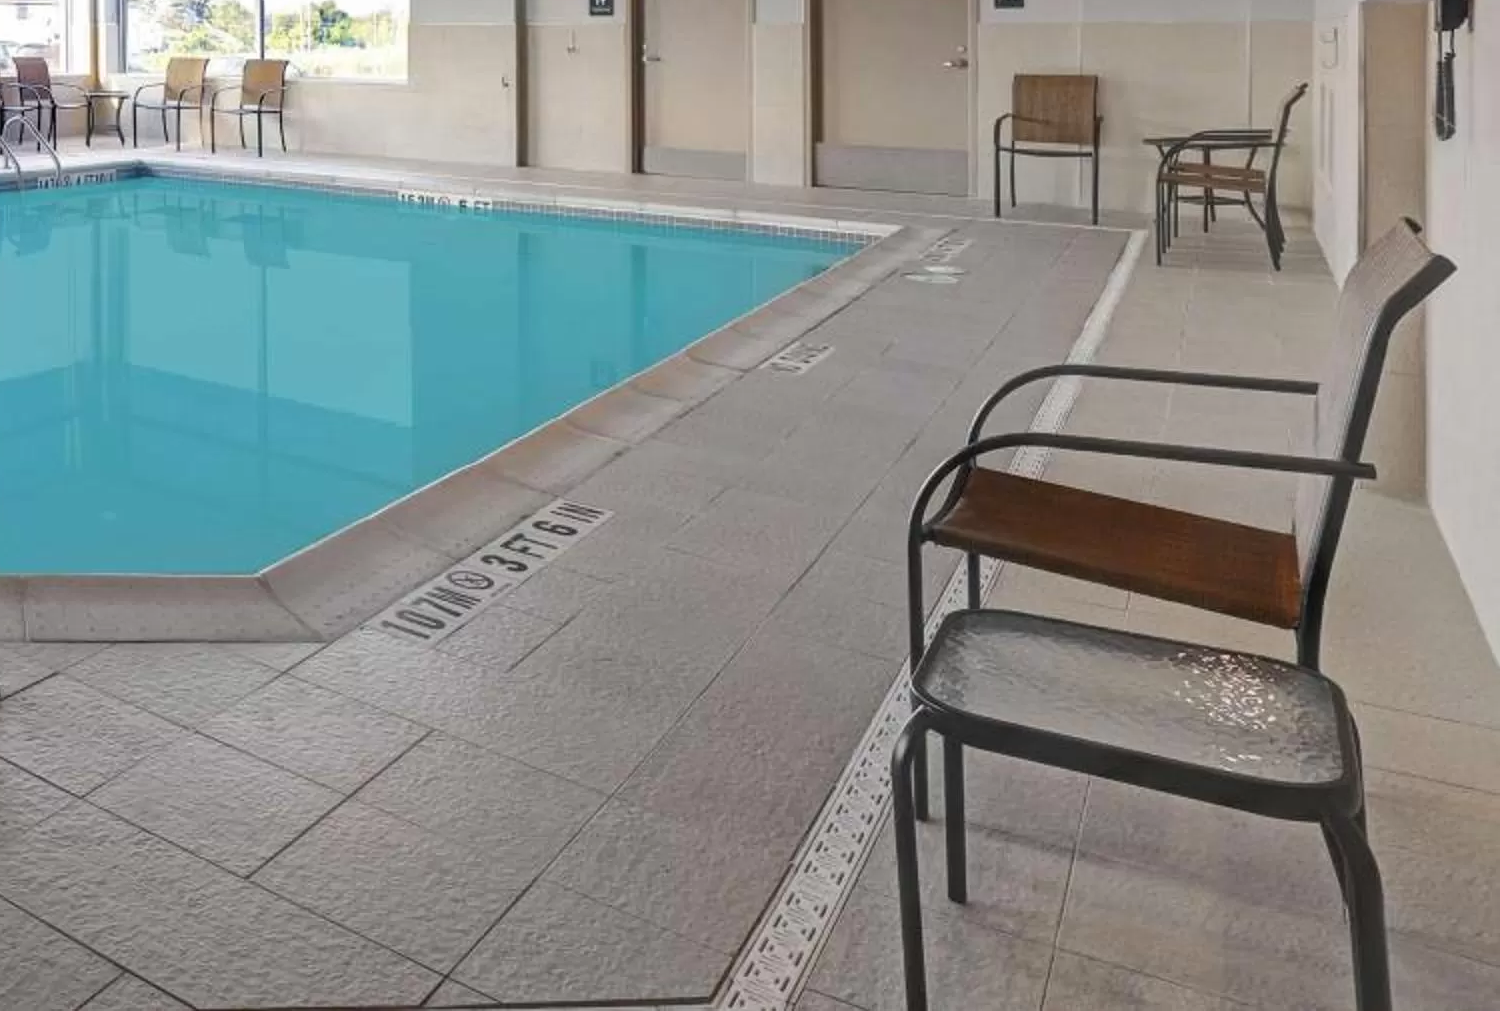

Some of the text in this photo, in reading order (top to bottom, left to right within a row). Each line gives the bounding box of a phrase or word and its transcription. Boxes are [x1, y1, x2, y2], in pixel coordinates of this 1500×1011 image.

[550, 501, 605, 524] IN
[532, 519, 579, 537] 6
[499, 532, 559, 560] FT
[480, 554, 529, 573] 3
